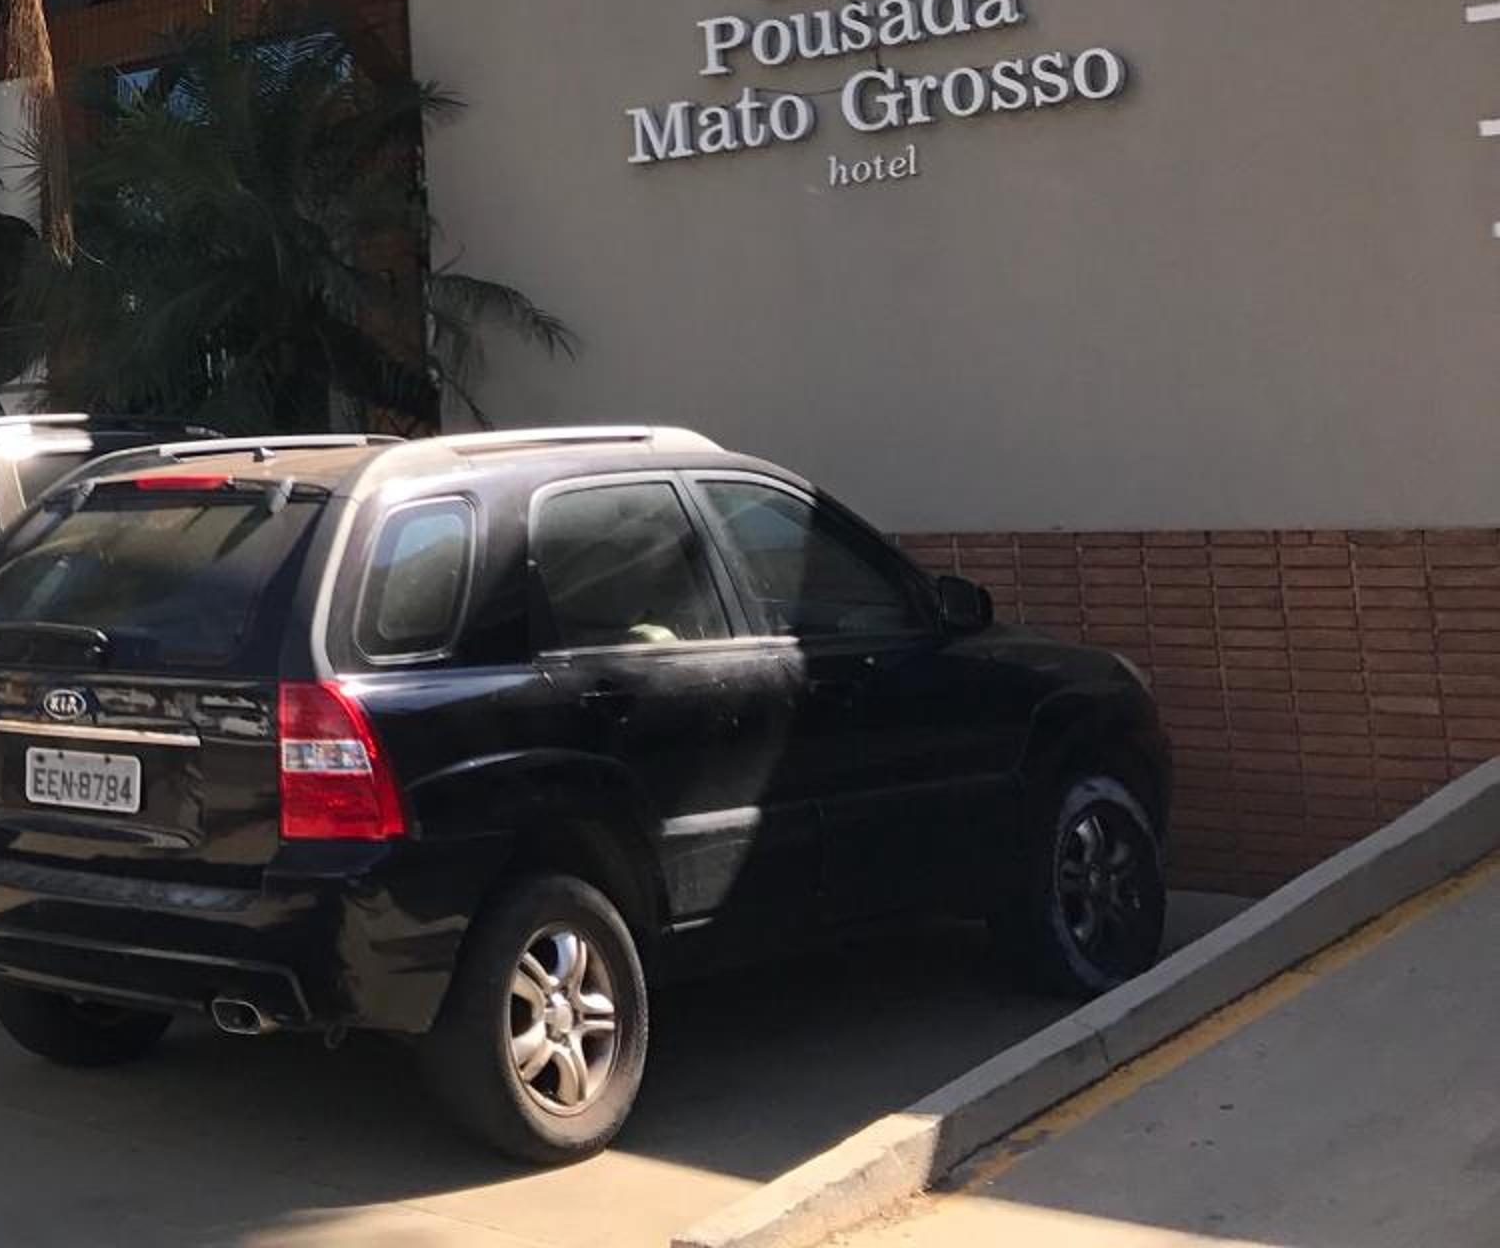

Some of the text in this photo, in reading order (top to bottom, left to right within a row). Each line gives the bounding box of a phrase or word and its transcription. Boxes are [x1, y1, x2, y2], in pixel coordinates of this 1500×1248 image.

[625, 48, 1127, 164] Mato Grosso
[828, 145, 918, 186] hotel
[49, 695, 79, 714] KIA
